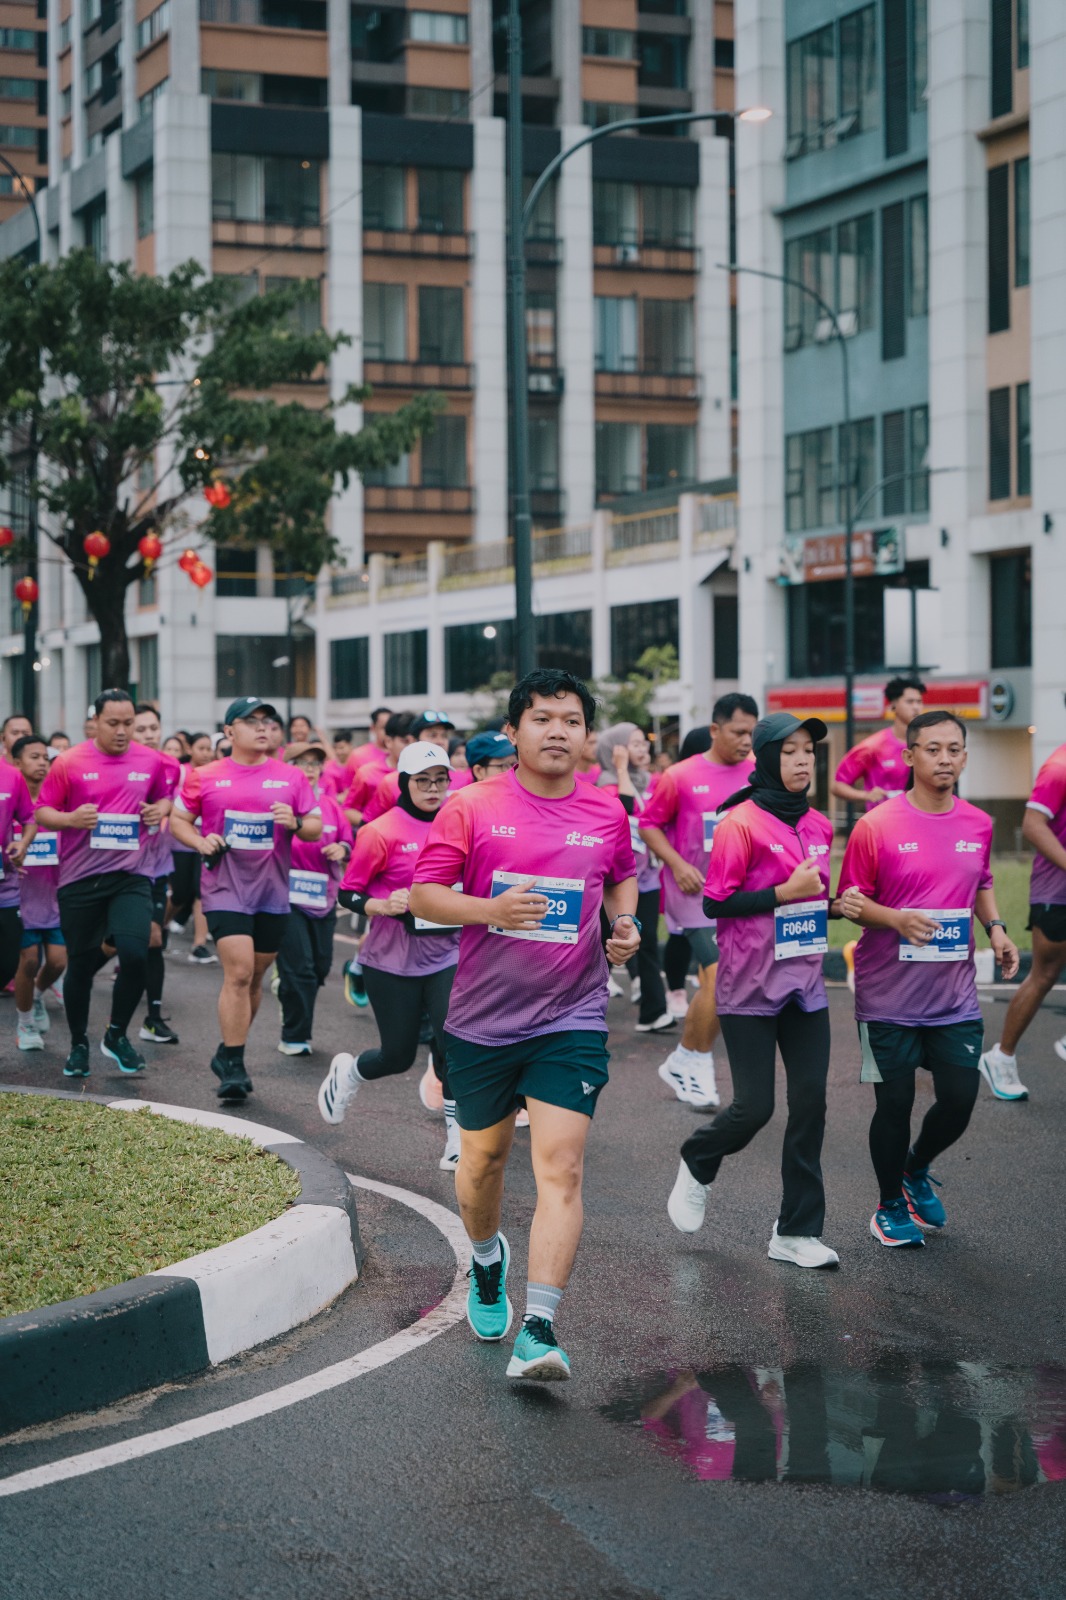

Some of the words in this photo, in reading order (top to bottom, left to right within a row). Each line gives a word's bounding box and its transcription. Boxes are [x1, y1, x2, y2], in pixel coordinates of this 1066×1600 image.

[232, 823, 268, 836] M0703
[491, 825, 516, 835] LCC
[898, 842, 918, 851] LCC
[782, 919, 817, 937] F0646
[923, 926, 961, 940] 645
